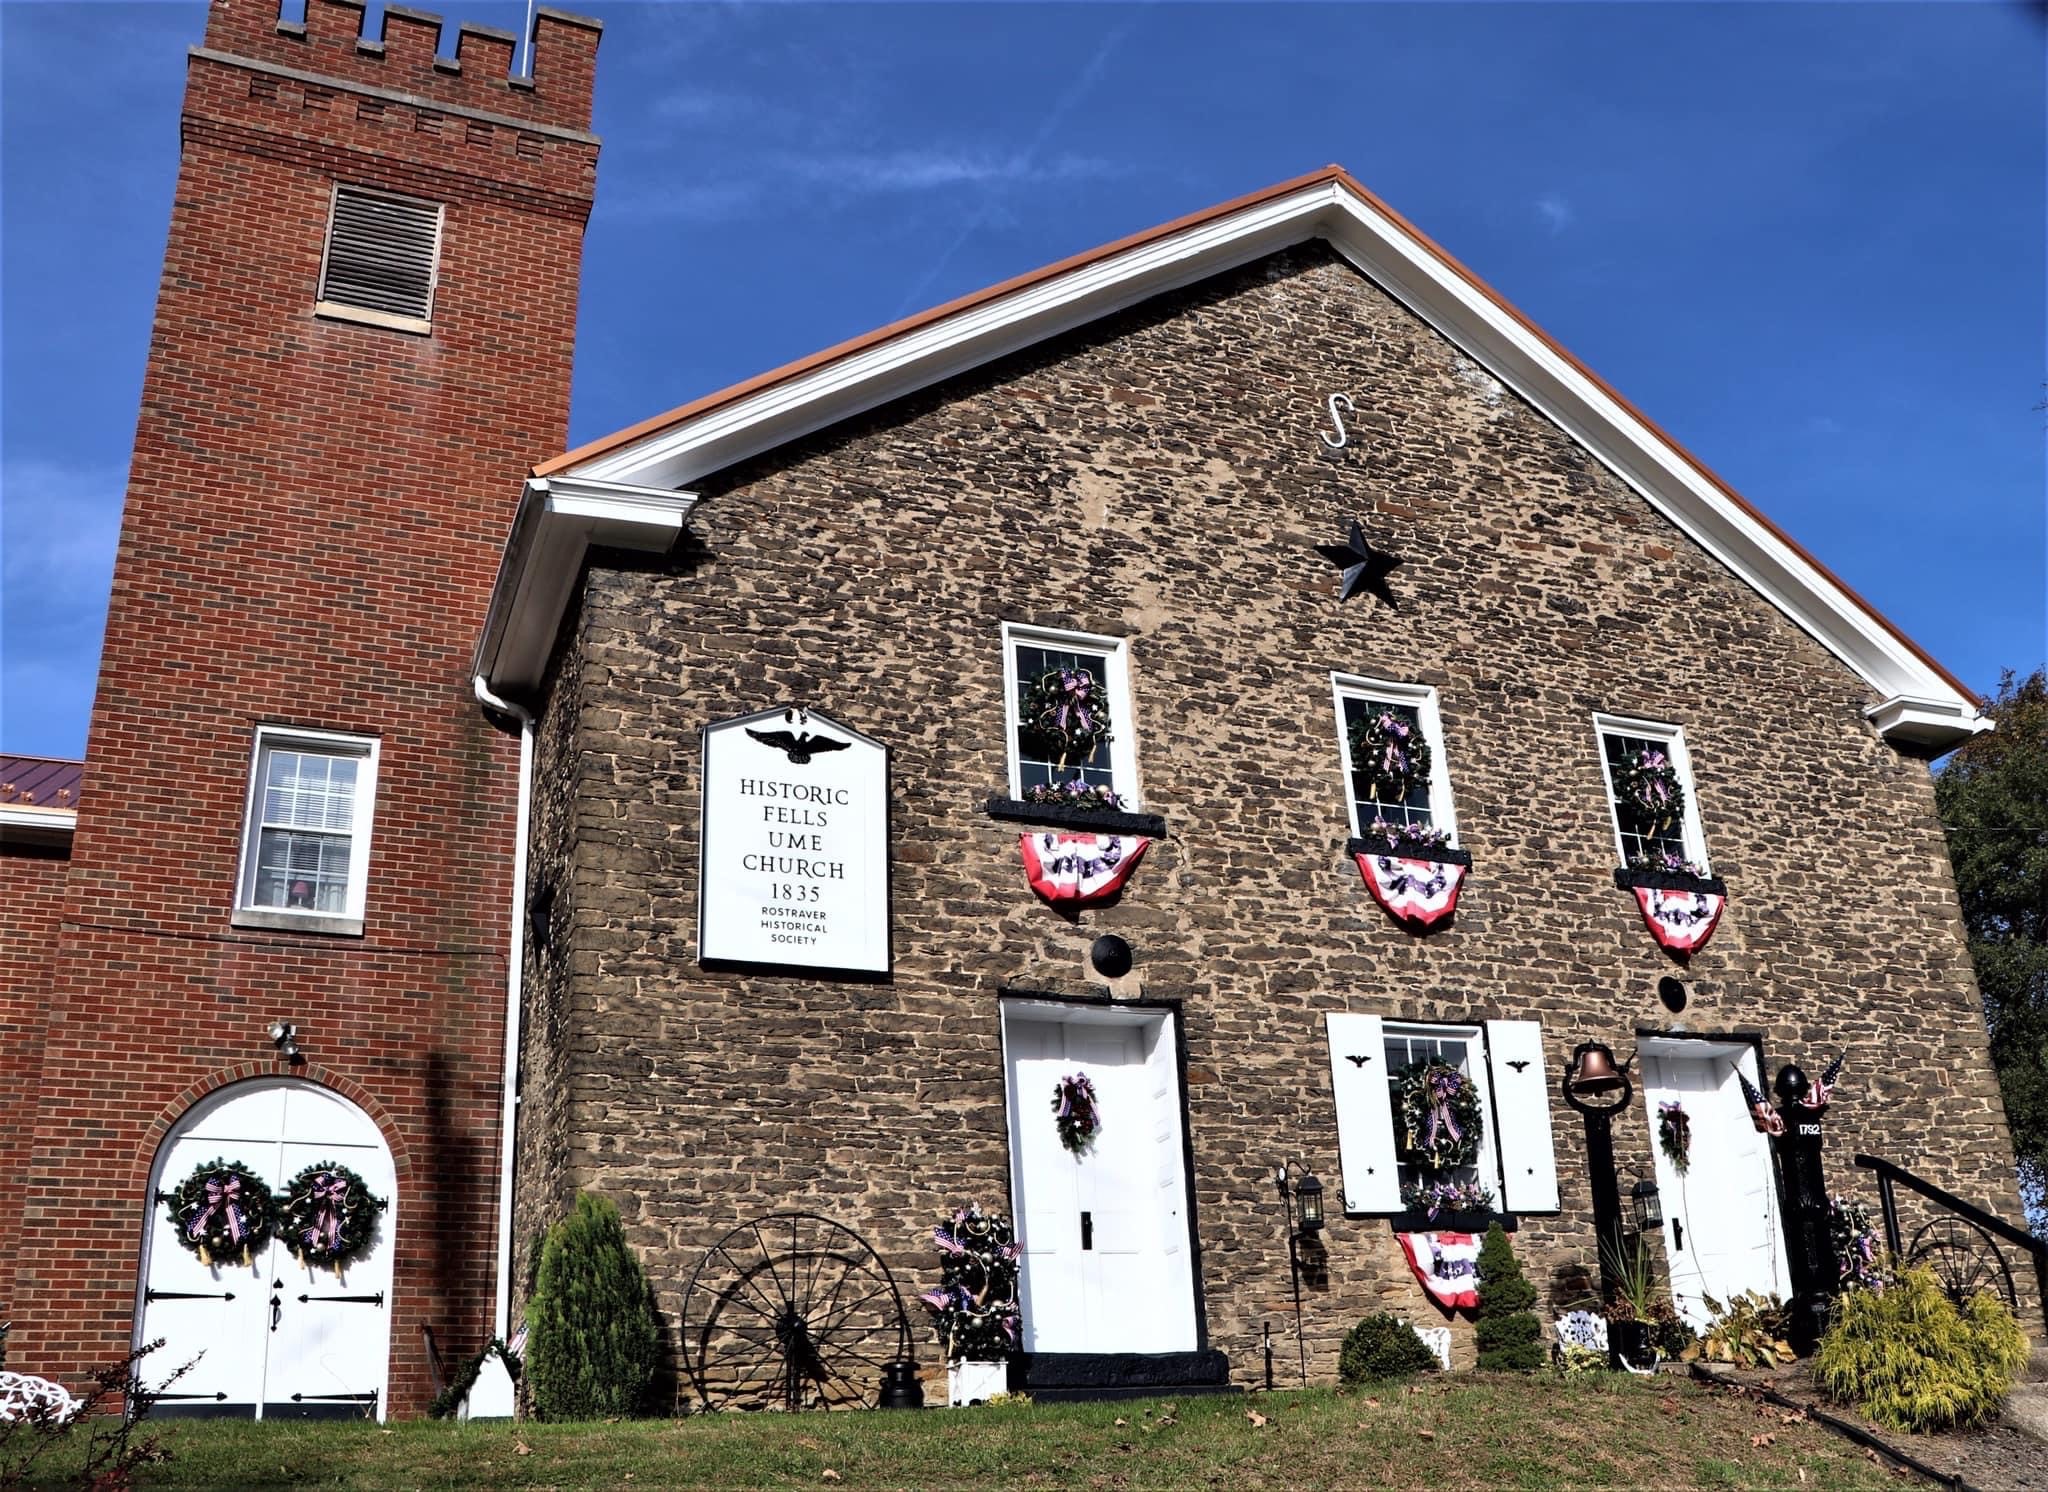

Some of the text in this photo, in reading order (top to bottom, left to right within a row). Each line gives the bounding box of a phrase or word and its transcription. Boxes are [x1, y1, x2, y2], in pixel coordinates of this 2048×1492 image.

[740, 778, 849, 806] HISTORIC
[763, 805, 828, 827] FELLS
[768, 831, 823, 852] UME
[742, 854, 844, 880] CHURCH
[771, 883, 820, 903] 1835
[761, 906, 827, 920] ROSTRAVER
[761, 920, 827, 934] HISTORICAL
[771, 933, 817, 945] SOCIETY
